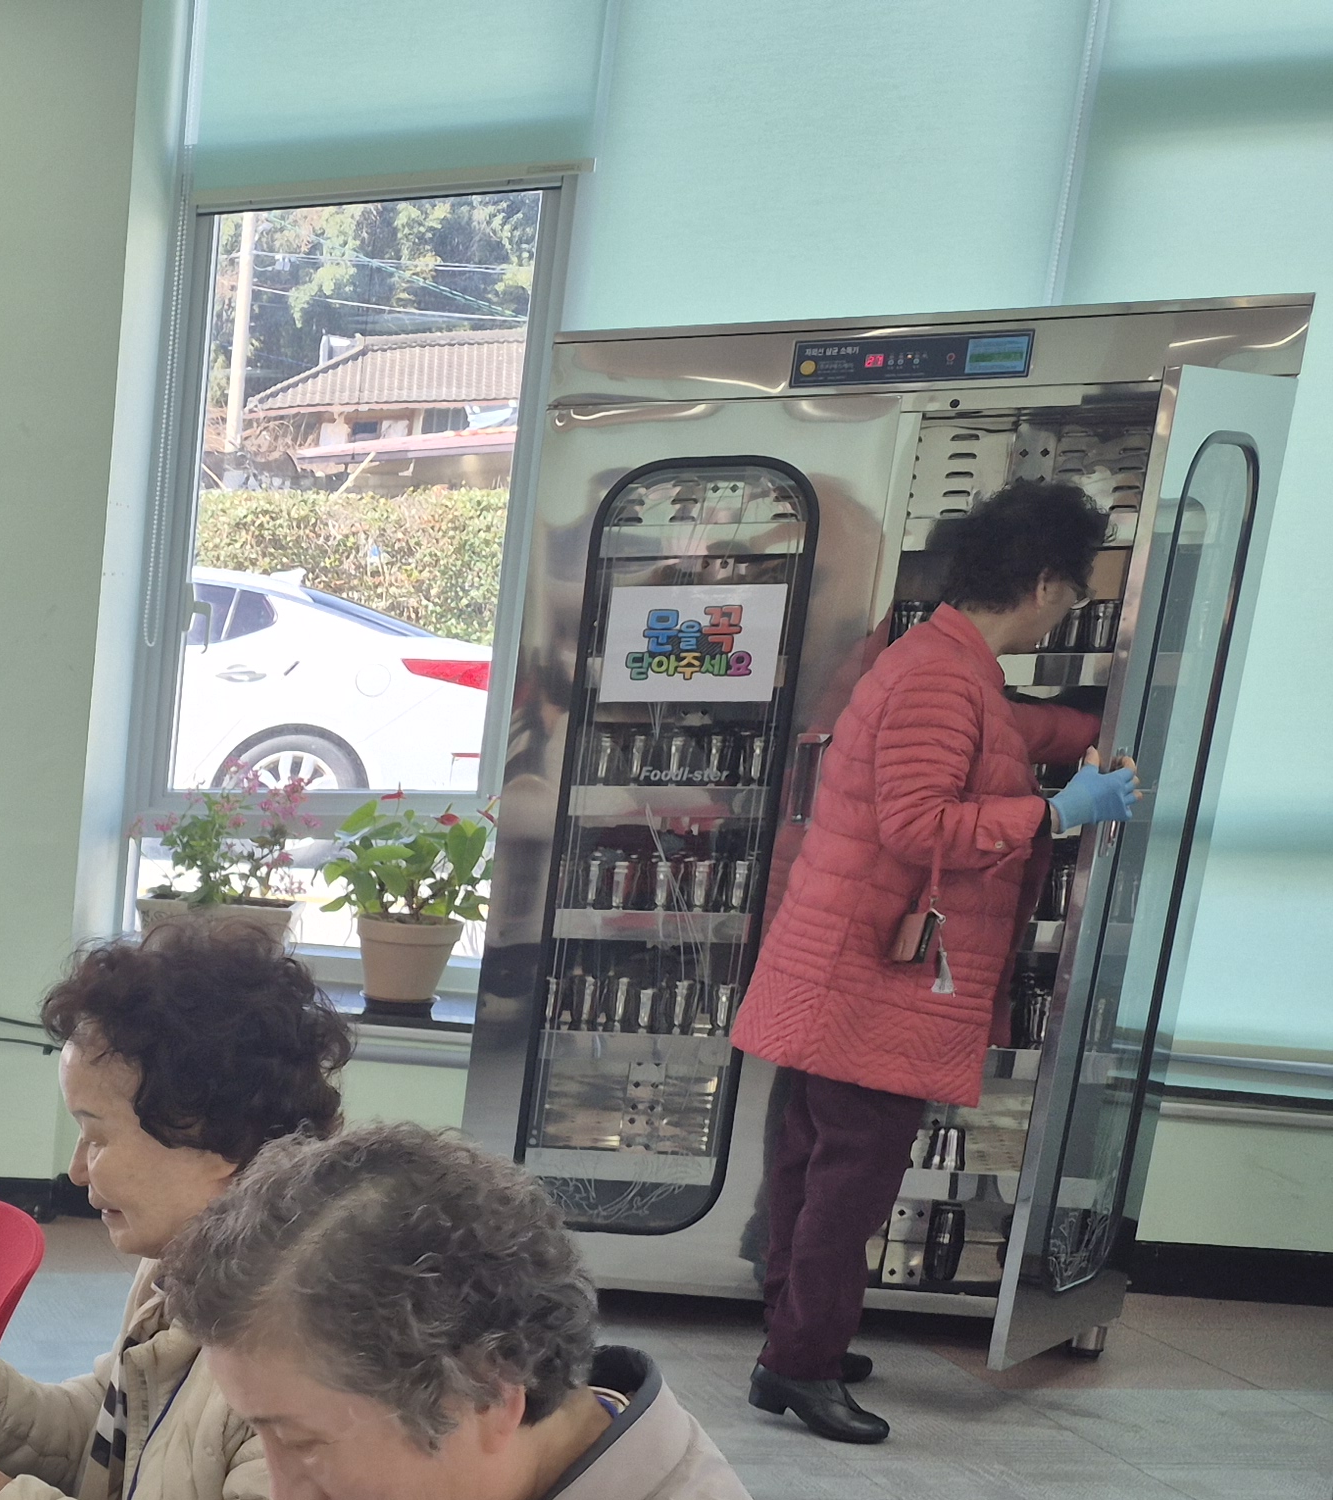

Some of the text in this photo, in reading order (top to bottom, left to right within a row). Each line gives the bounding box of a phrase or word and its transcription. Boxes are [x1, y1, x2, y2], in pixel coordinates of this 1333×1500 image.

[642, 604, 743, 653] 문을 꼭
[625, 650, 752, 680] 닫아주세요
